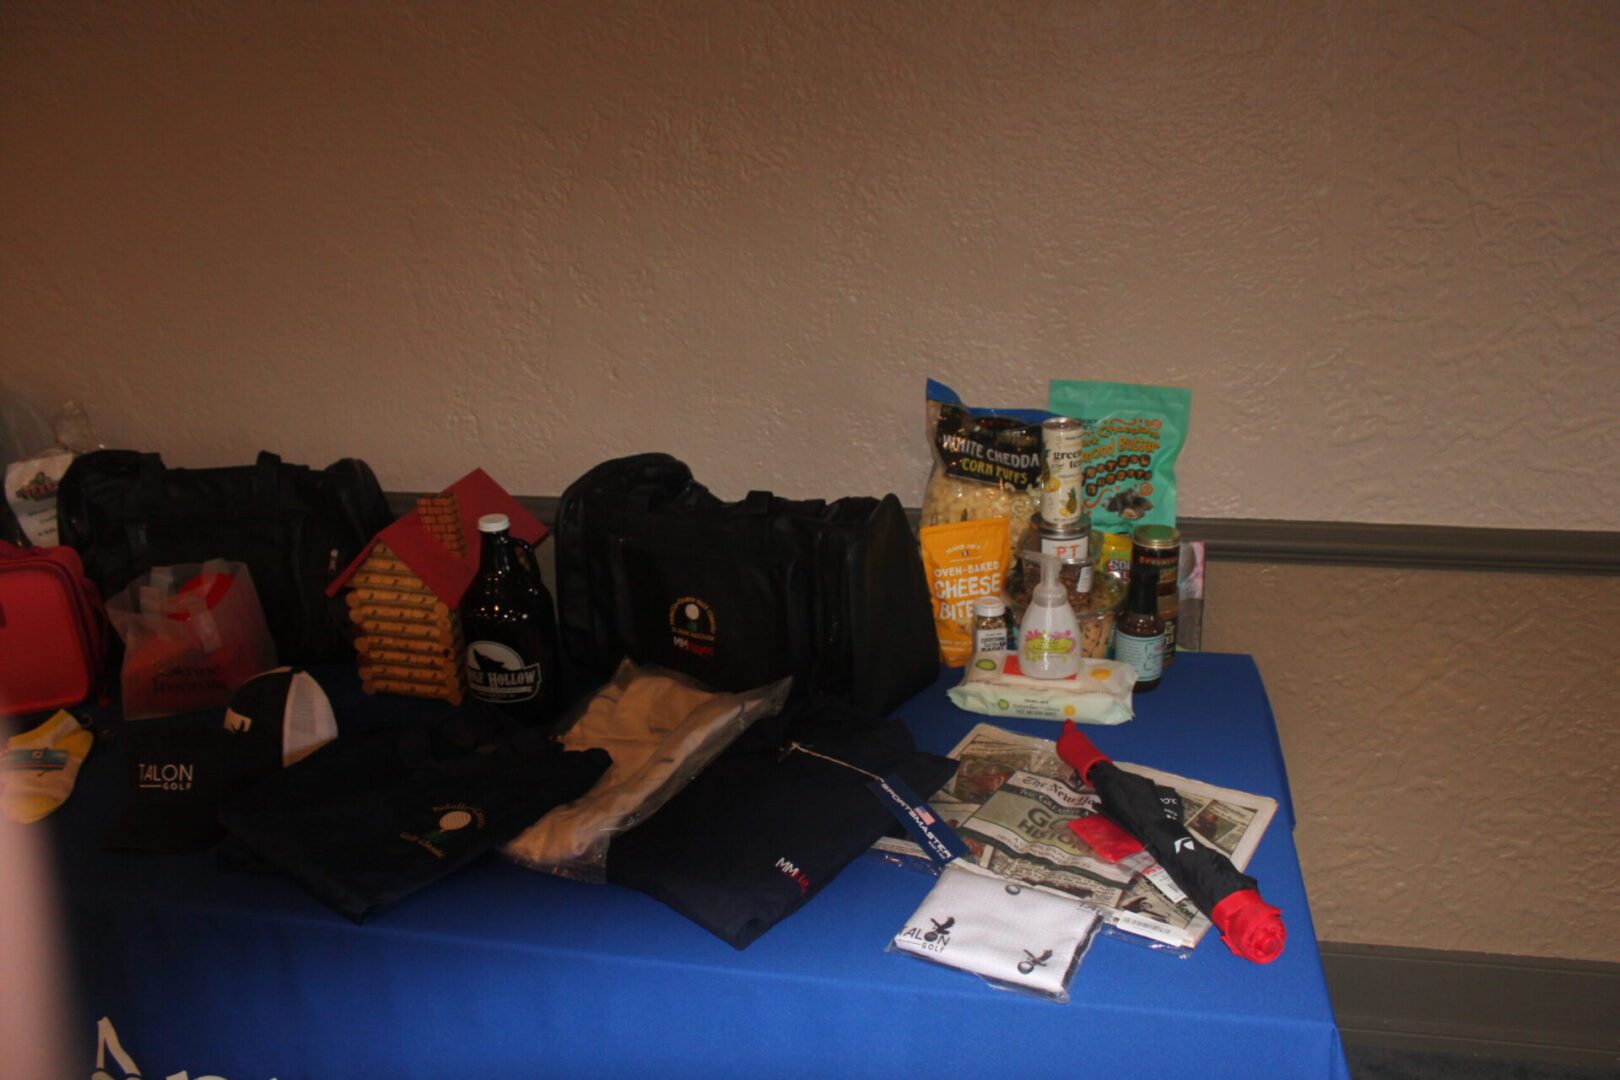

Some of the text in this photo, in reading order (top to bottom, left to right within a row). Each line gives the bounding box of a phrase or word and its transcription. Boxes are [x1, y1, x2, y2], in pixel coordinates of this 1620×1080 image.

[961, 458, 994, 477] CORN
[986, 447, 1040, 469] CHEDDA
[934, 560, 1000, 578] OVEN-BAKED
[934, 572, 1002, 599] CHEESE
[940, 599, 976, 621] BITE
[487, 668, 537, 688] HOLLOW
[139, 763, 194, 781] TALON
[162, 783, 192, 791] GOLF
[880, 782, 953, 858] SPORTSMASTER
[921, 942, 945, 953] GOLF
